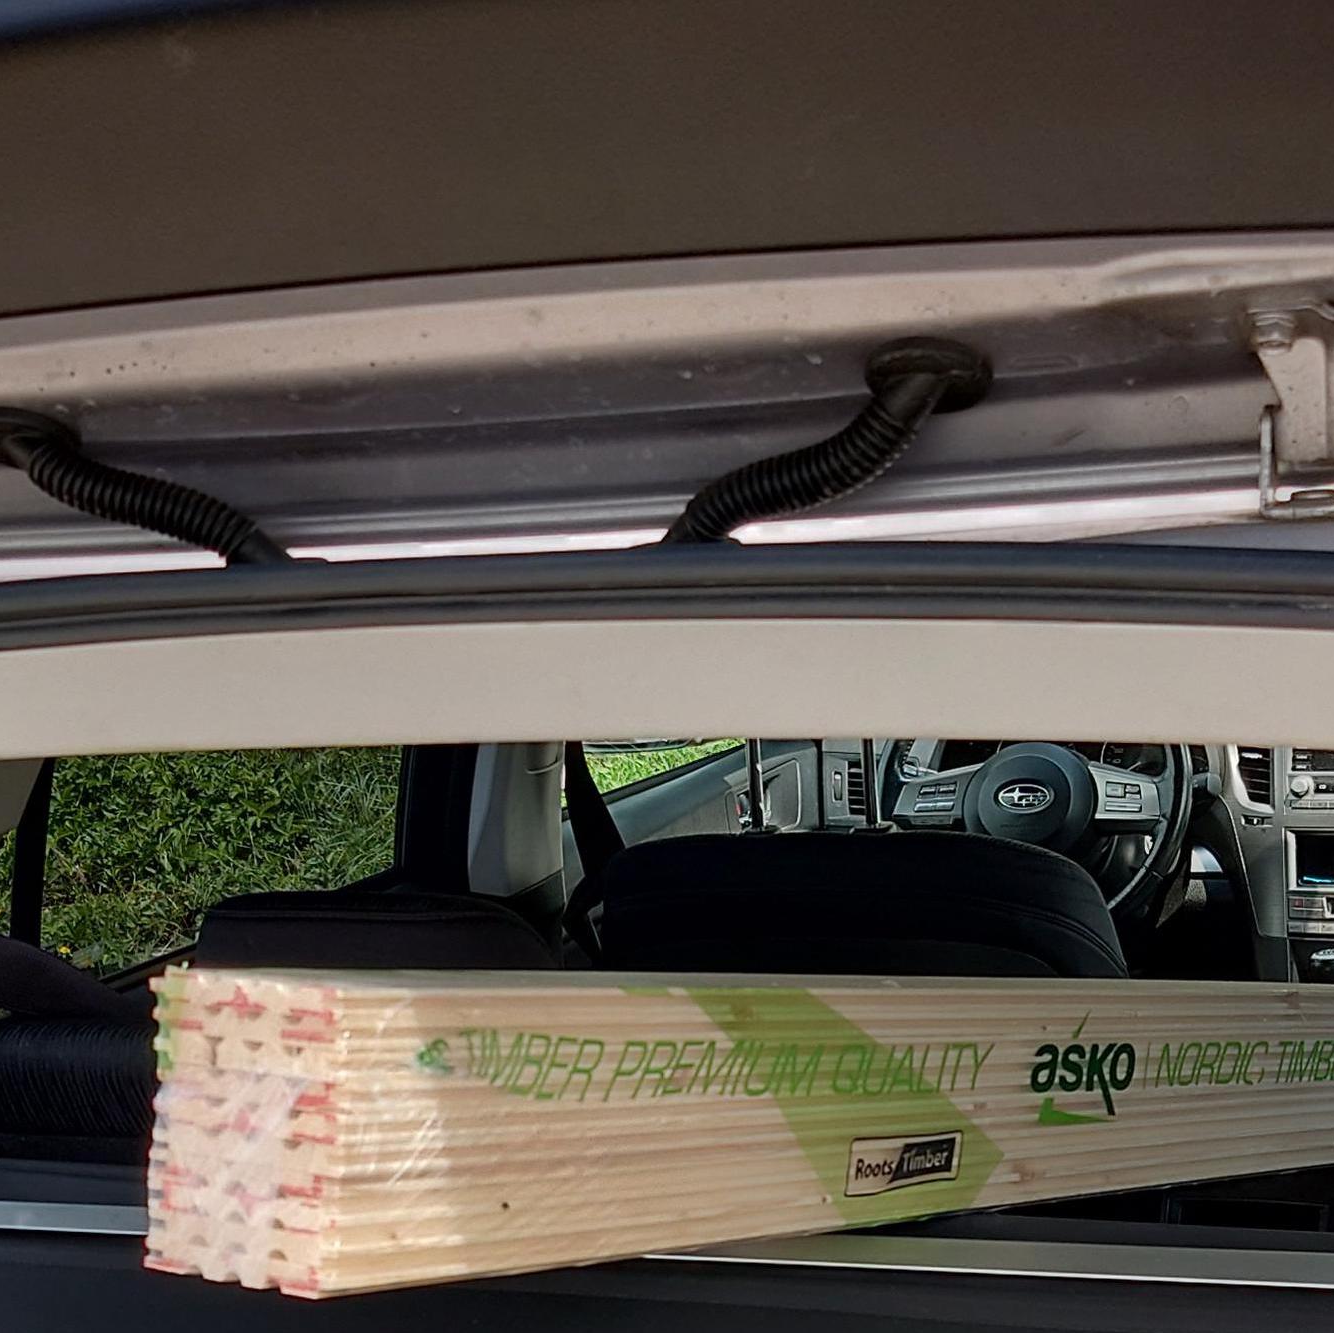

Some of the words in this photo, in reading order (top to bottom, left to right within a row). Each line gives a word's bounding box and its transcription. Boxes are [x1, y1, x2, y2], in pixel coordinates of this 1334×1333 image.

[458, 1028, 605, 1102] TIMBER
[603, 1039, 825, 1101] PREMIUM
[831, 1042, 995, 1097] QUALITY
[1029, 1042, 1137, 1116] asko
[1154, 1040, 1269, 1089] NORDIC
[854, 1157, 895, 1181] Roots
[900, 1148, 949, 1174] Timber
